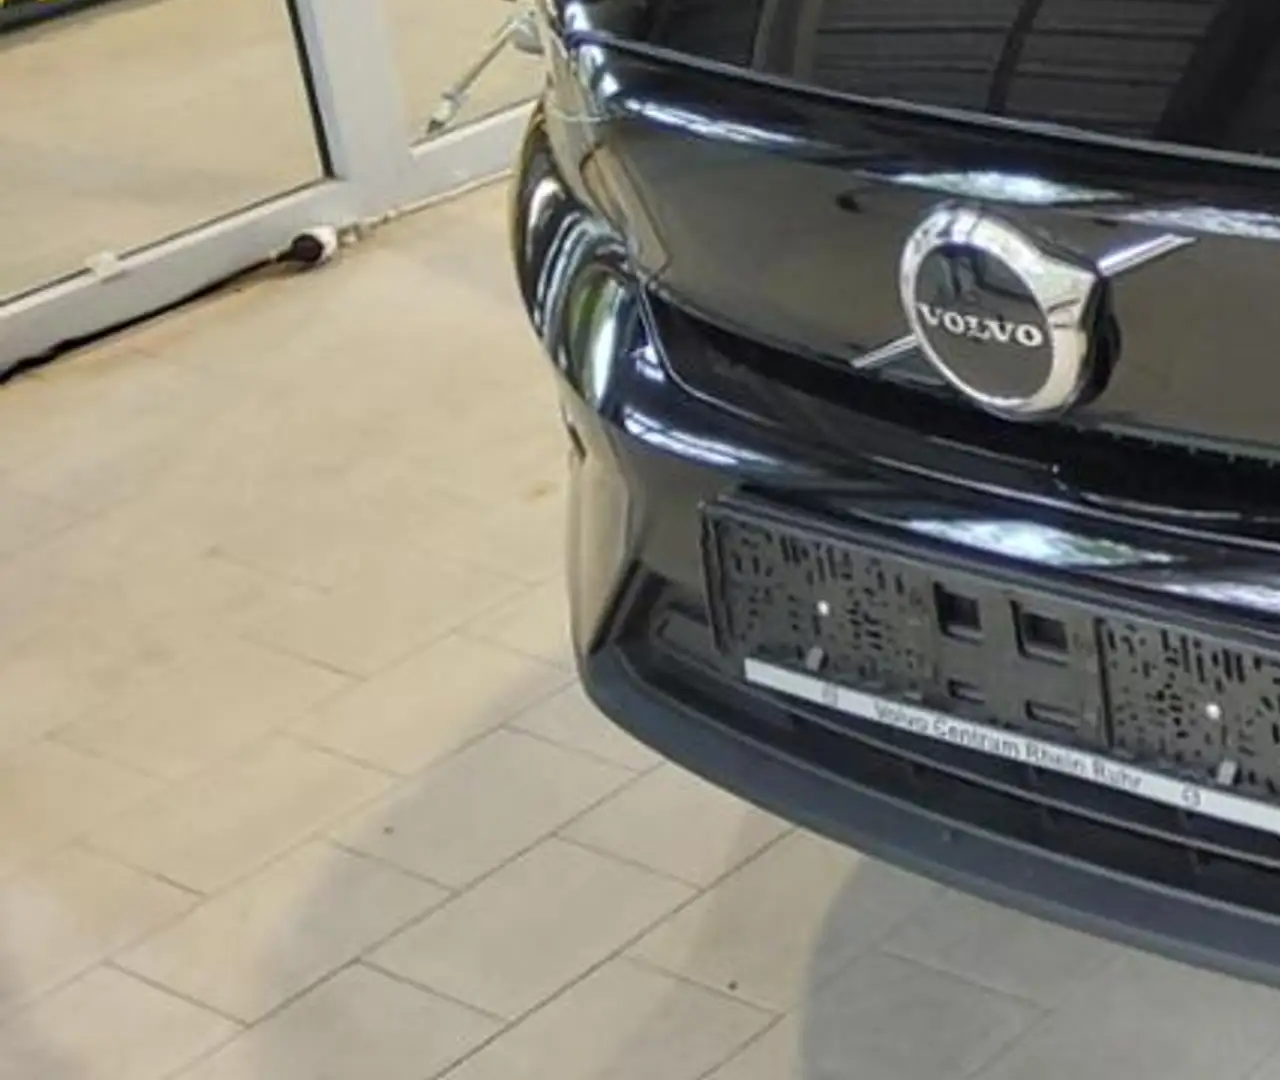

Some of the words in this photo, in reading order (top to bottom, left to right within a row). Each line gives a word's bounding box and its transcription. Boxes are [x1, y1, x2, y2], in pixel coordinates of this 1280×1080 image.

[917, 302, 1043, 347] VOLVO
[873, 699, 929, 732] Volvo
[932, 719, 1021, 760] Centrum
[1025, 740, 1087, 773] Rhein
[1091, 757, 1144, 789] Ruhr
